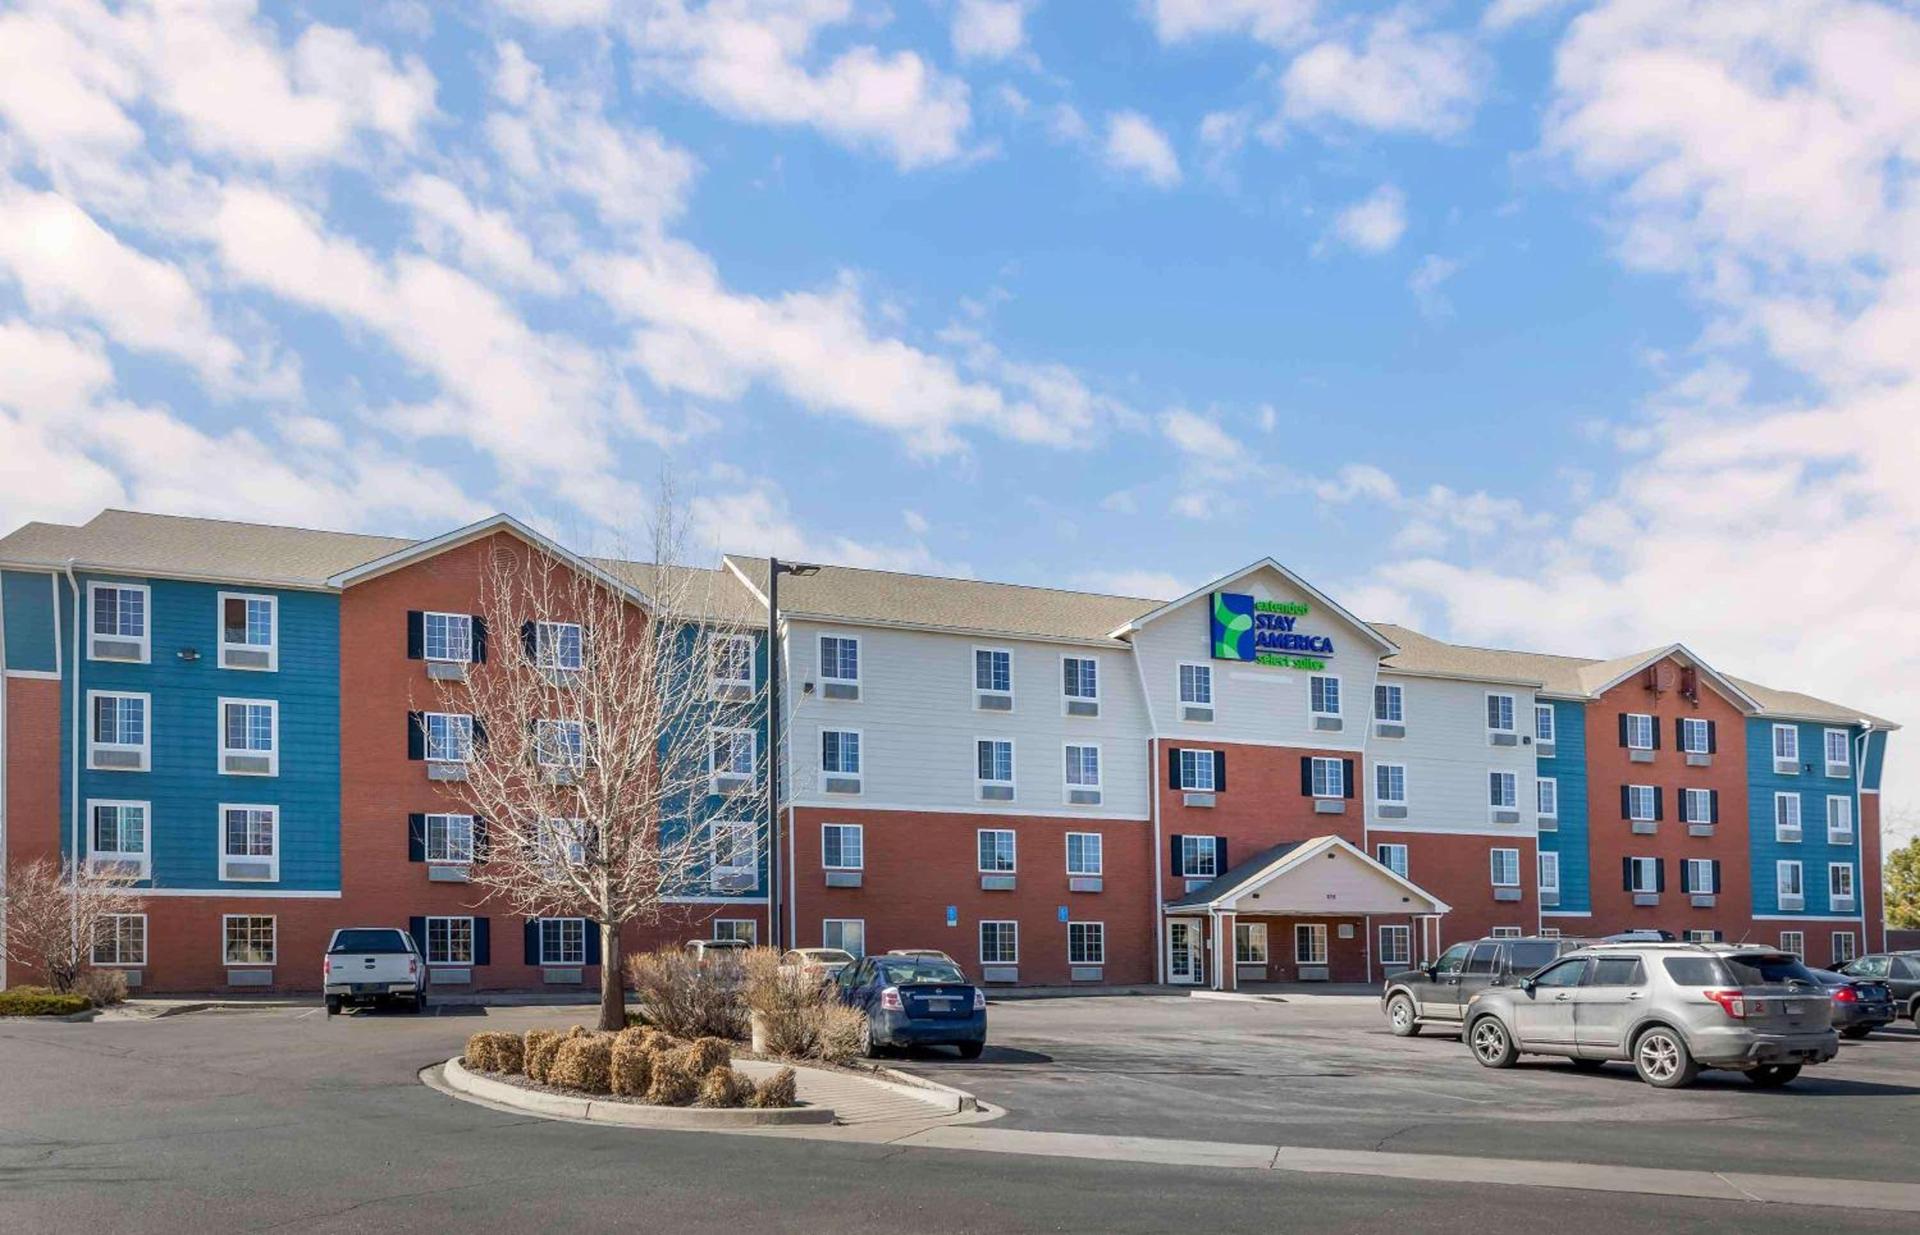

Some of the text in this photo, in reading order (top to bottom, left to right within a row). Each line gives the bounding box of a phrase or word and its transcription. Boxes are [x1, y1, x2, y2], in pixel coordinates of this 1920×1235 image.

[1256, 614, 1296, 632] STAY
[1256, 632, 1334, 653] AMERICA
[1256, 654, 1325, 671] select suites
